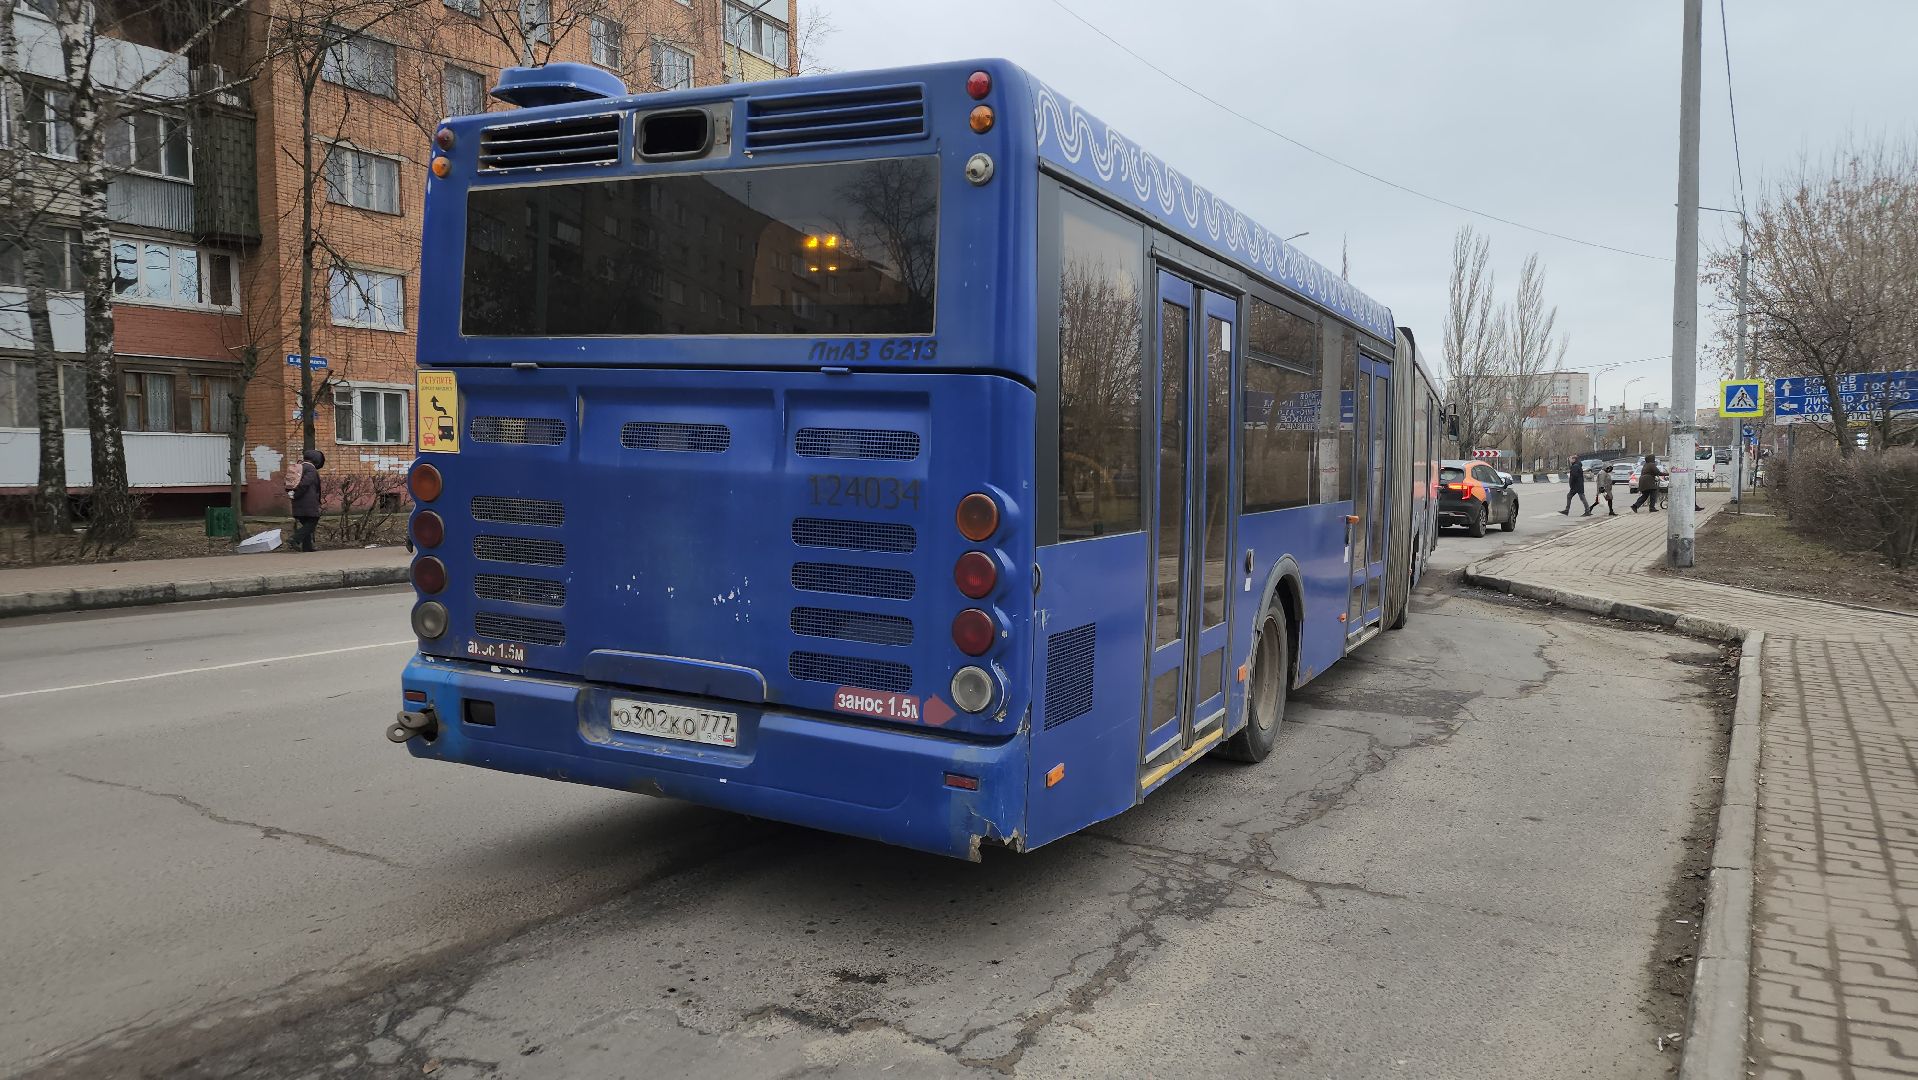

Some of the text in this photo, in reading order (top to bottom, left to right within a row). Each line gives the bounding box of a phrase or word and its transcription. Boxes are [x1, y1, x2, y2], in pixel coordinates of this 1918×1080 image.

[879, 340, 938, 361] 6213
[420, 376, 452, 385] УСТУПИТЕ
[808, 474, 920, 512] 124034
[838, 693, 884, 714] занос
[700, 712, 728, 735] 777
